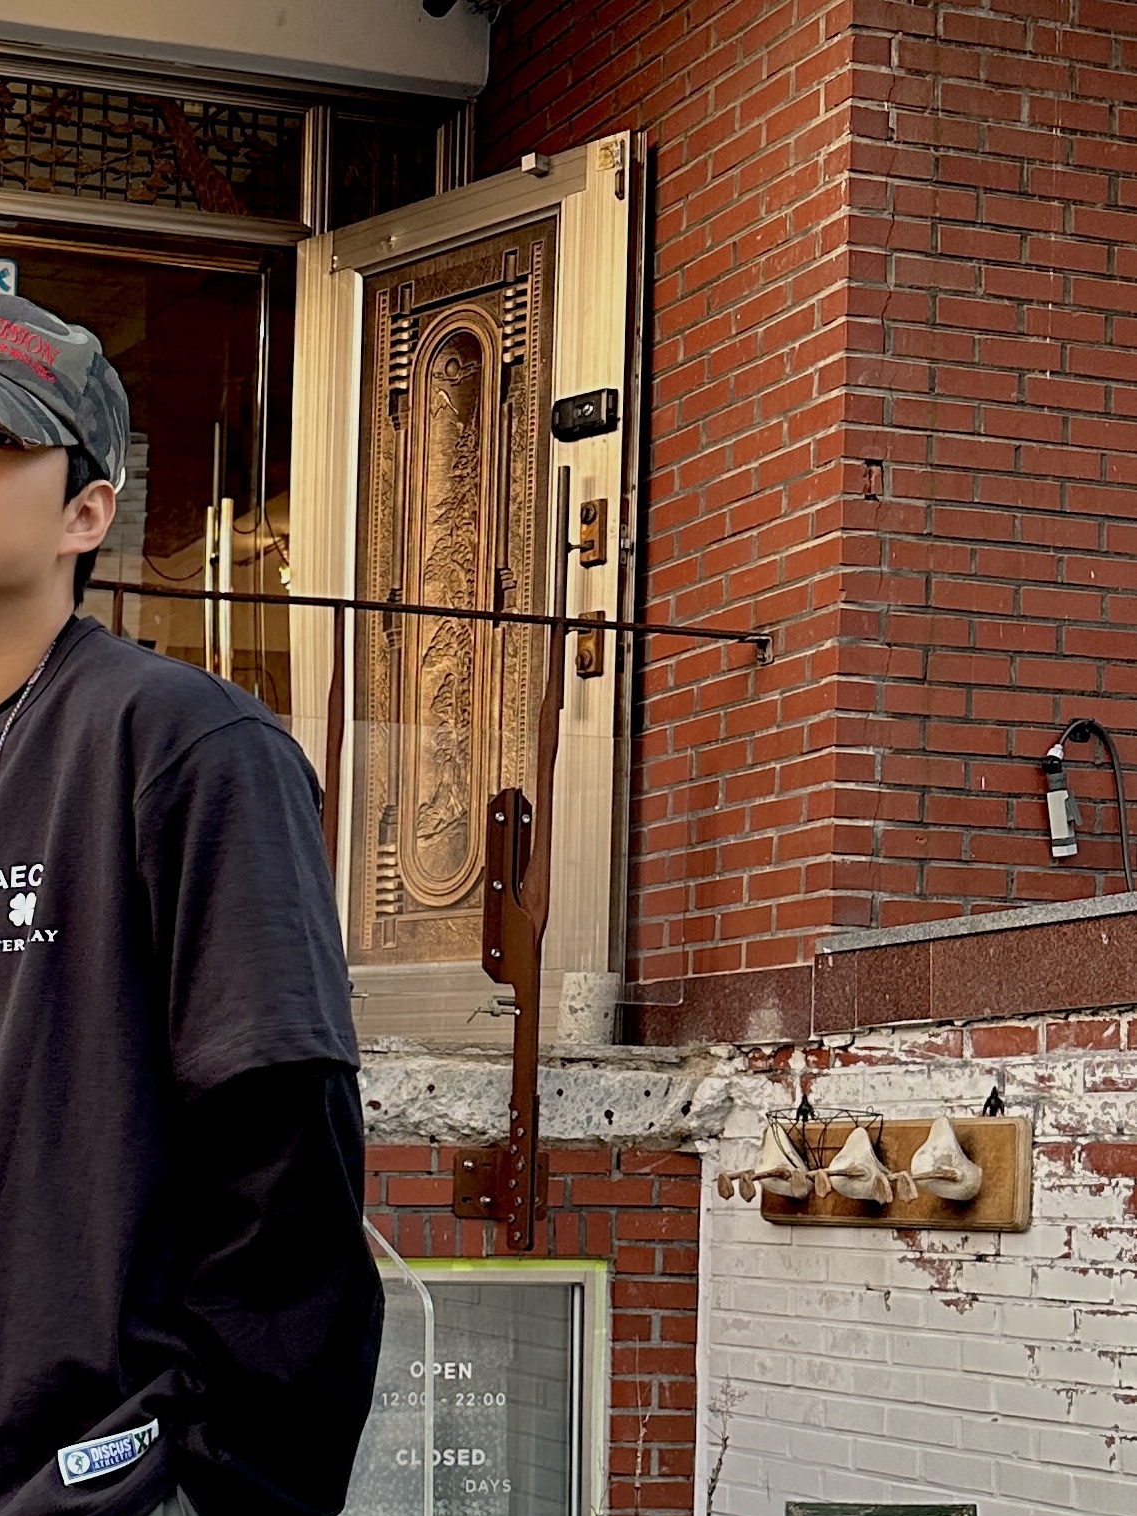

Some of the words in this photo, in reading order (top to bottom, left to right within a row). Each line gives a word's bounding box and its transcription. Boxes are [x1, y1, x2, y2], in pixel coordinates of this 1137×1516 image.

[410, 1361, 473, 1380] OPEN
[455, 1392, 507, 1407] 22:00
[90, 1438, 132, 1462] DISCUS
[395, 1449, 486, 1467] CLOSED
[465, 1479, 512, 1493] DAYS
